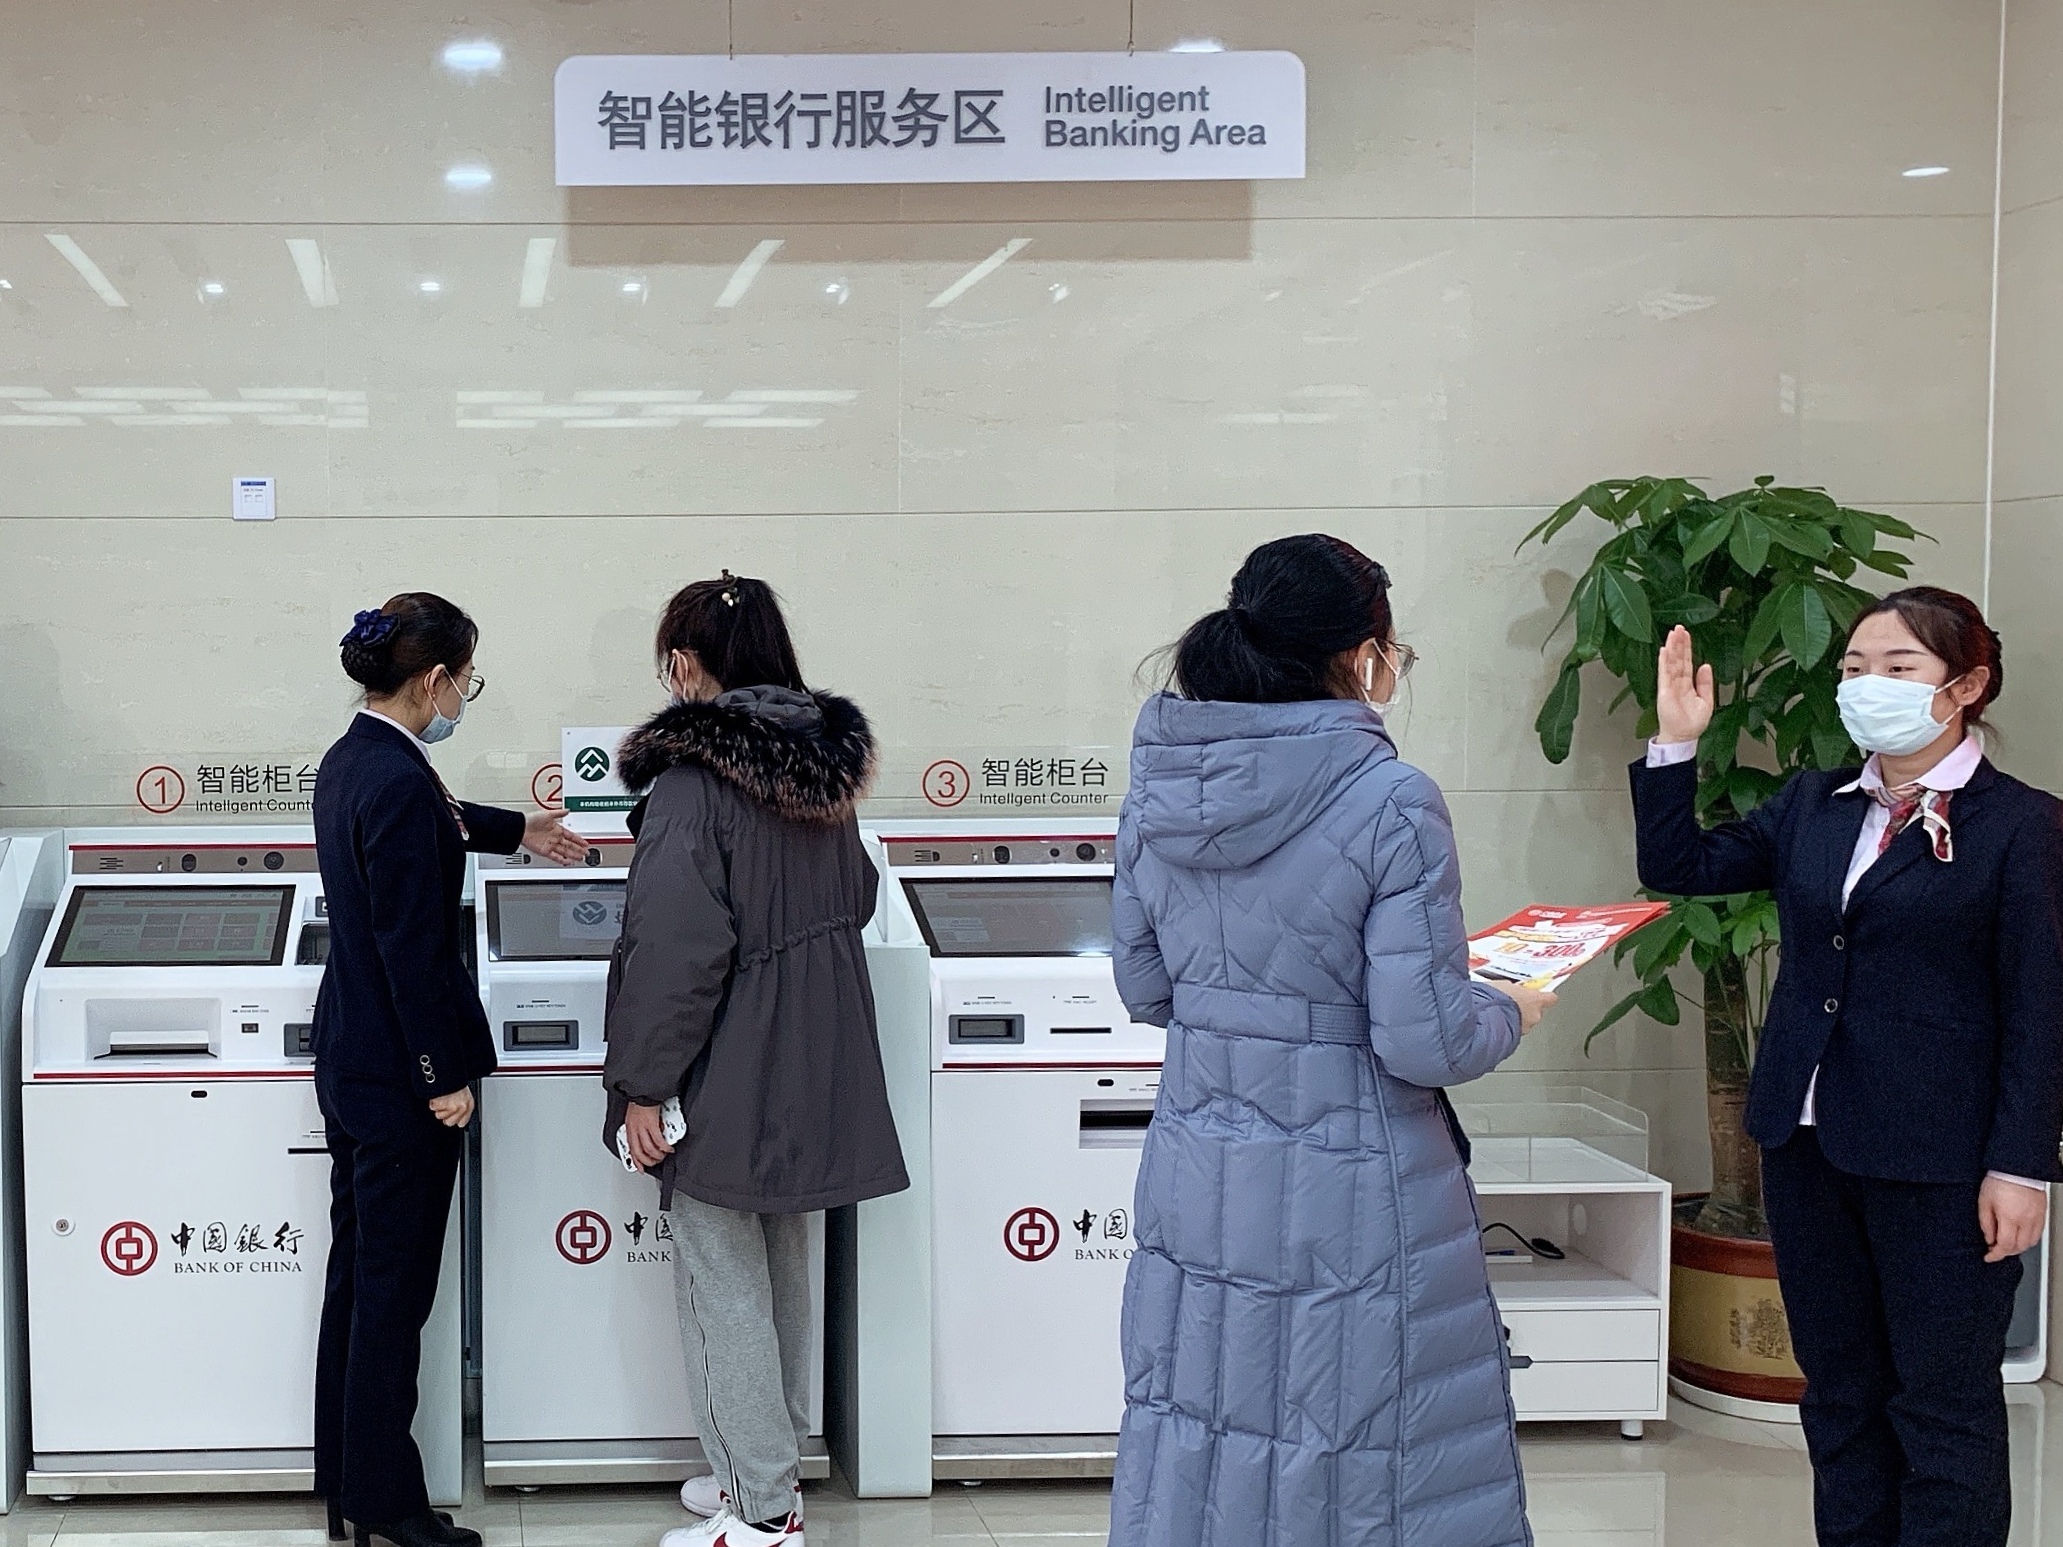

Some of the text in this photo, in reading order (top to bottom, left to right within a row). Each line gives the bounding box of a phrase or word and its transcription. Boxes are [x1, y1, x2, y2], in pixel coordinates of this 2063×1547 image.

[1045, 84, 1210, 119] Intelligent
[597, 86, 1006, 150] 智能银行服务区
[1045, 118, 1267, 153] Banking Area
[196, 763, 319, 795] 智能柜台
[982, 757, 1109, 788] 智能柜台
[266, 798, 315, 812] Count
[1050, 791, 1109, 805] Counter
[1072, 1208, 1129, 1244] 中國
[174, 1260, 303, 1274] BANK OF CHINA
[627, 1250, 673, 1263] BANK
[1074, 1248, 1134, 1261] BANK O
